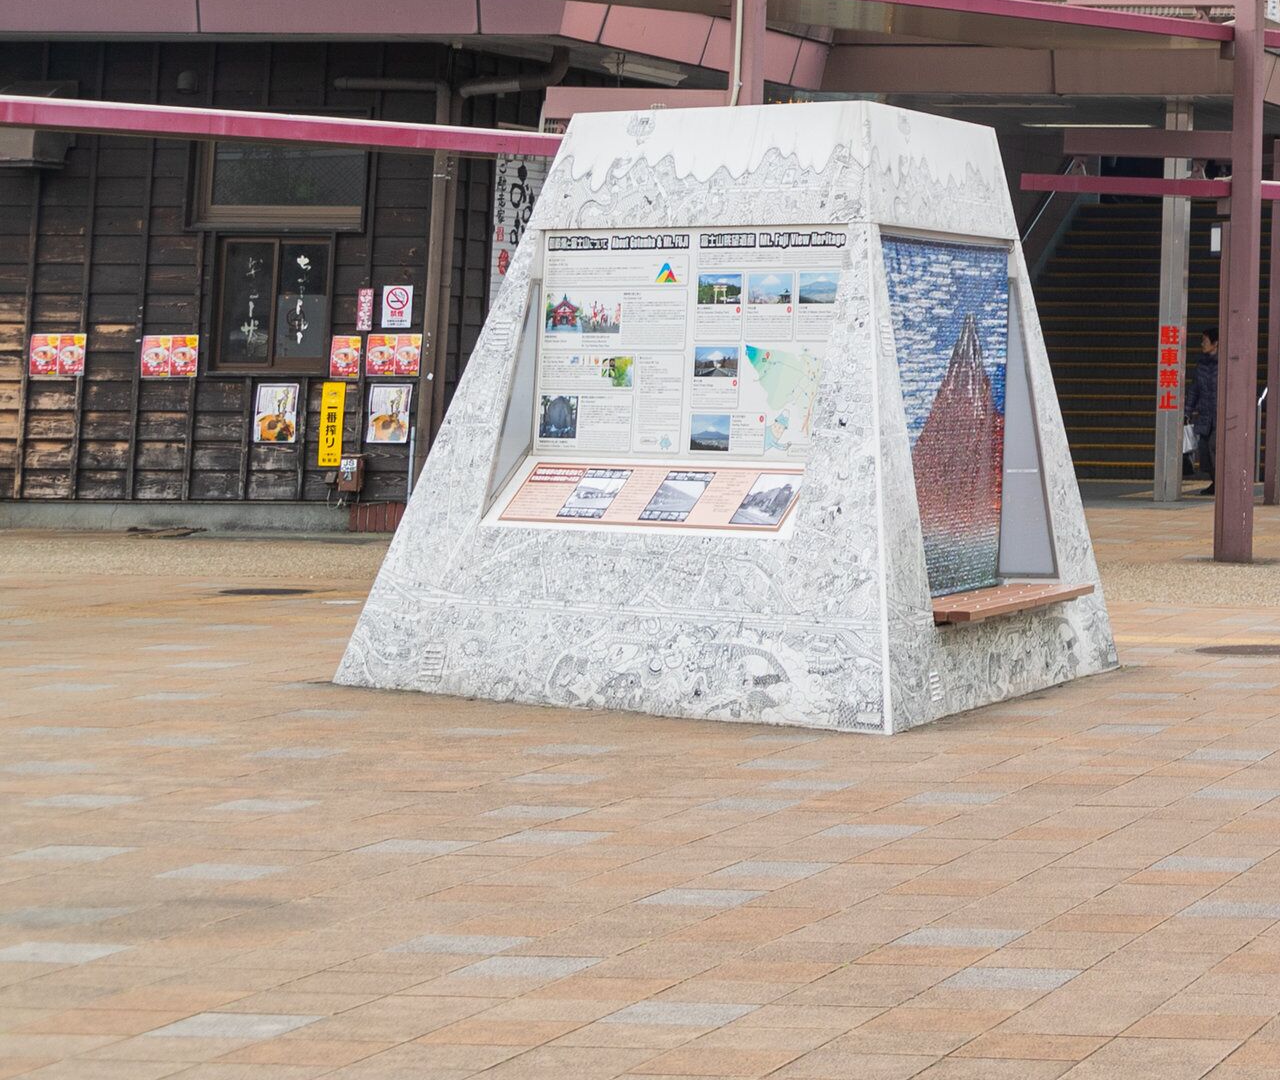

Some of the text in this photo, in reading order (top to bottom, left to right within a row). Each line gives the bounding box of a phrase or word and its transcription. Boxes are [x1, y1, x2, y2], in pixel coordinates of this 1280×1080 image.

[790, 232, 810, 248] View
[811, 231, 846, 249] Heritage
[1159, 325, 1179, 409] 駐車禁止
[325, 406, 339, 449] 一番搾り
